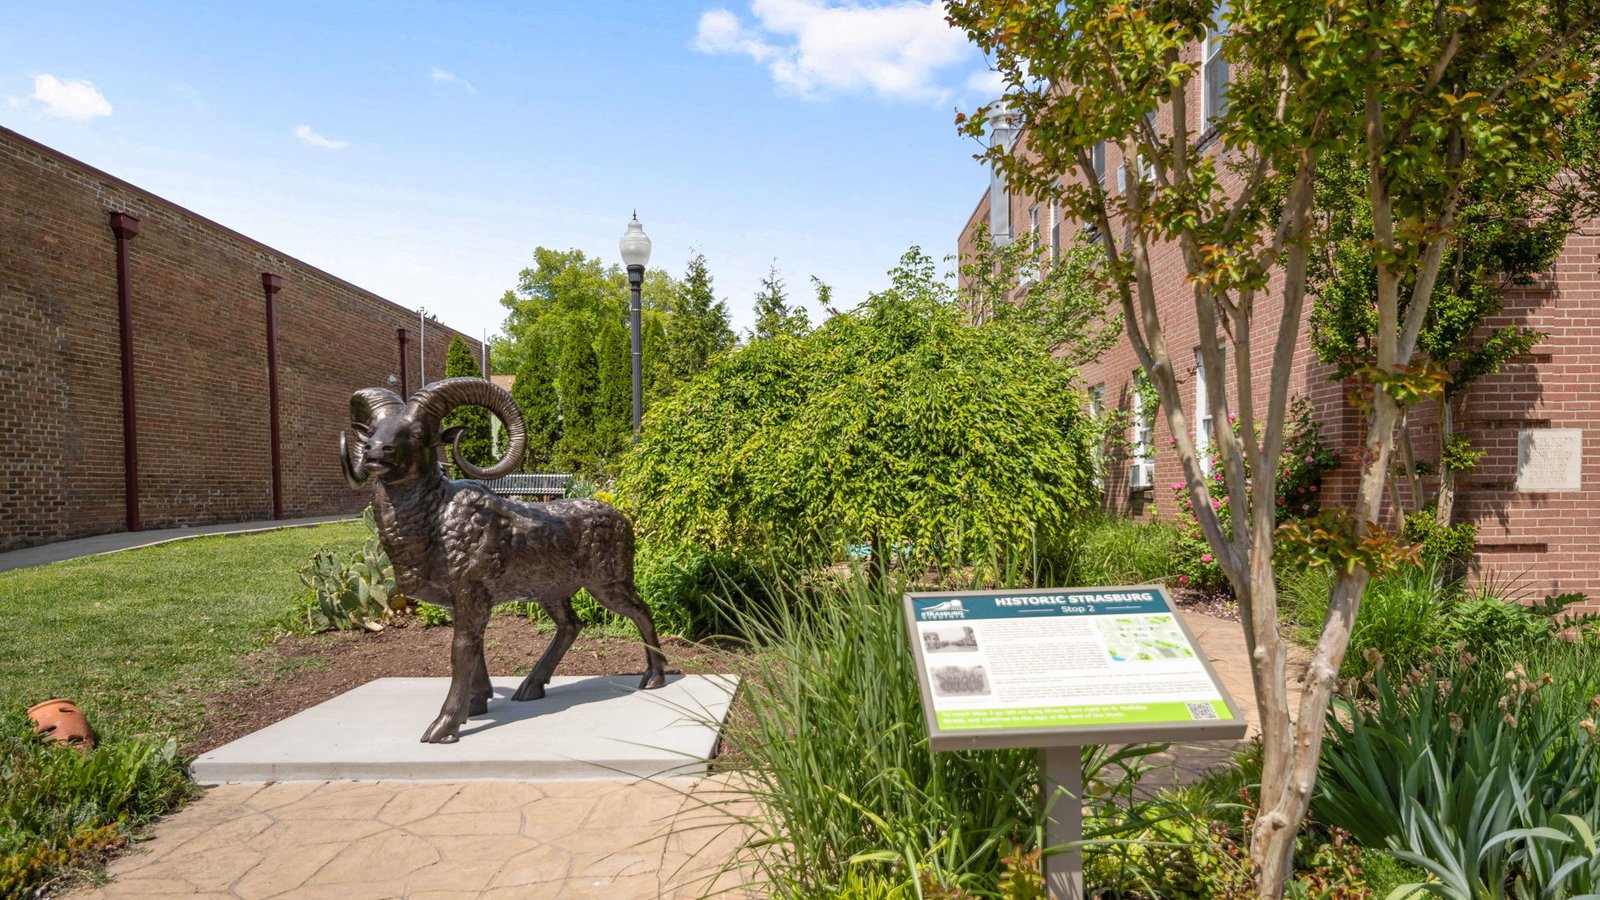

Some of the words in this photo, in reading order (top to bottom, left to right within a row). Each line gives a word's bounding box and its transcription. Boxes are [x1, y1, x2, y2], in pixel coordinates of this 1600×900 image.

[995, 595, 1066, 606] HISTORIC
[1068, 592, 1154, 604] STRASBURG
[1061, 605, 1085, 613] Stop
